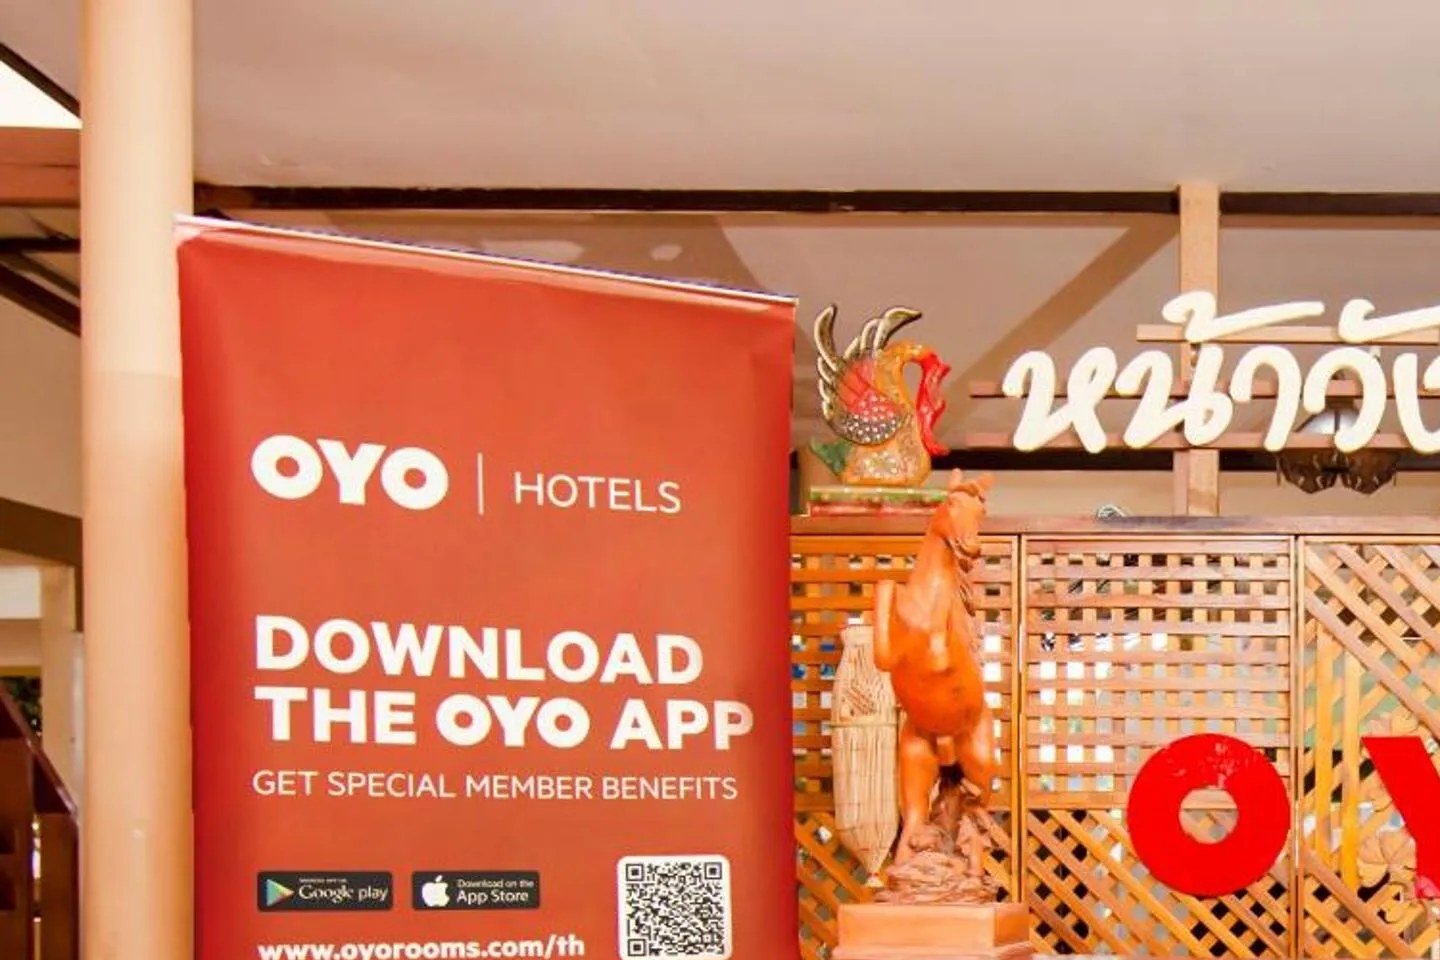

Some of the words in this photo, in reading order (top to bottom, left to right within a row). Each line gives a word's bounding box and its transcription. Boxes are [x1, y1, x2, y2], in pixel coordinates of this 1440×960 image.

[251, 434, 449, 510] OYO
[514, 471, 682, 514] HOTELS
[255, 614, 703, 685] DOWNLOAD
[254, 685, 417, 746] THE
[435, 693, 590, 748] OYO
[610, 699, 755, 750] APP
[252, 769, 319, 796] GET
[327, 771, 456, 798] SPECIAL
[465, 775, 593, 800] MEMBER
[602, 776, 738, 800] BENEFITS
[298, 884, 354, 904] Google
[358, 885, 389, 902] play
[456, 889, 489, 905] App
[490, 889, 529, 903] Store
[457, 879, 503, 888] Download
[505, 880, 517, 888] on
[519, 879, 535, 888] the
